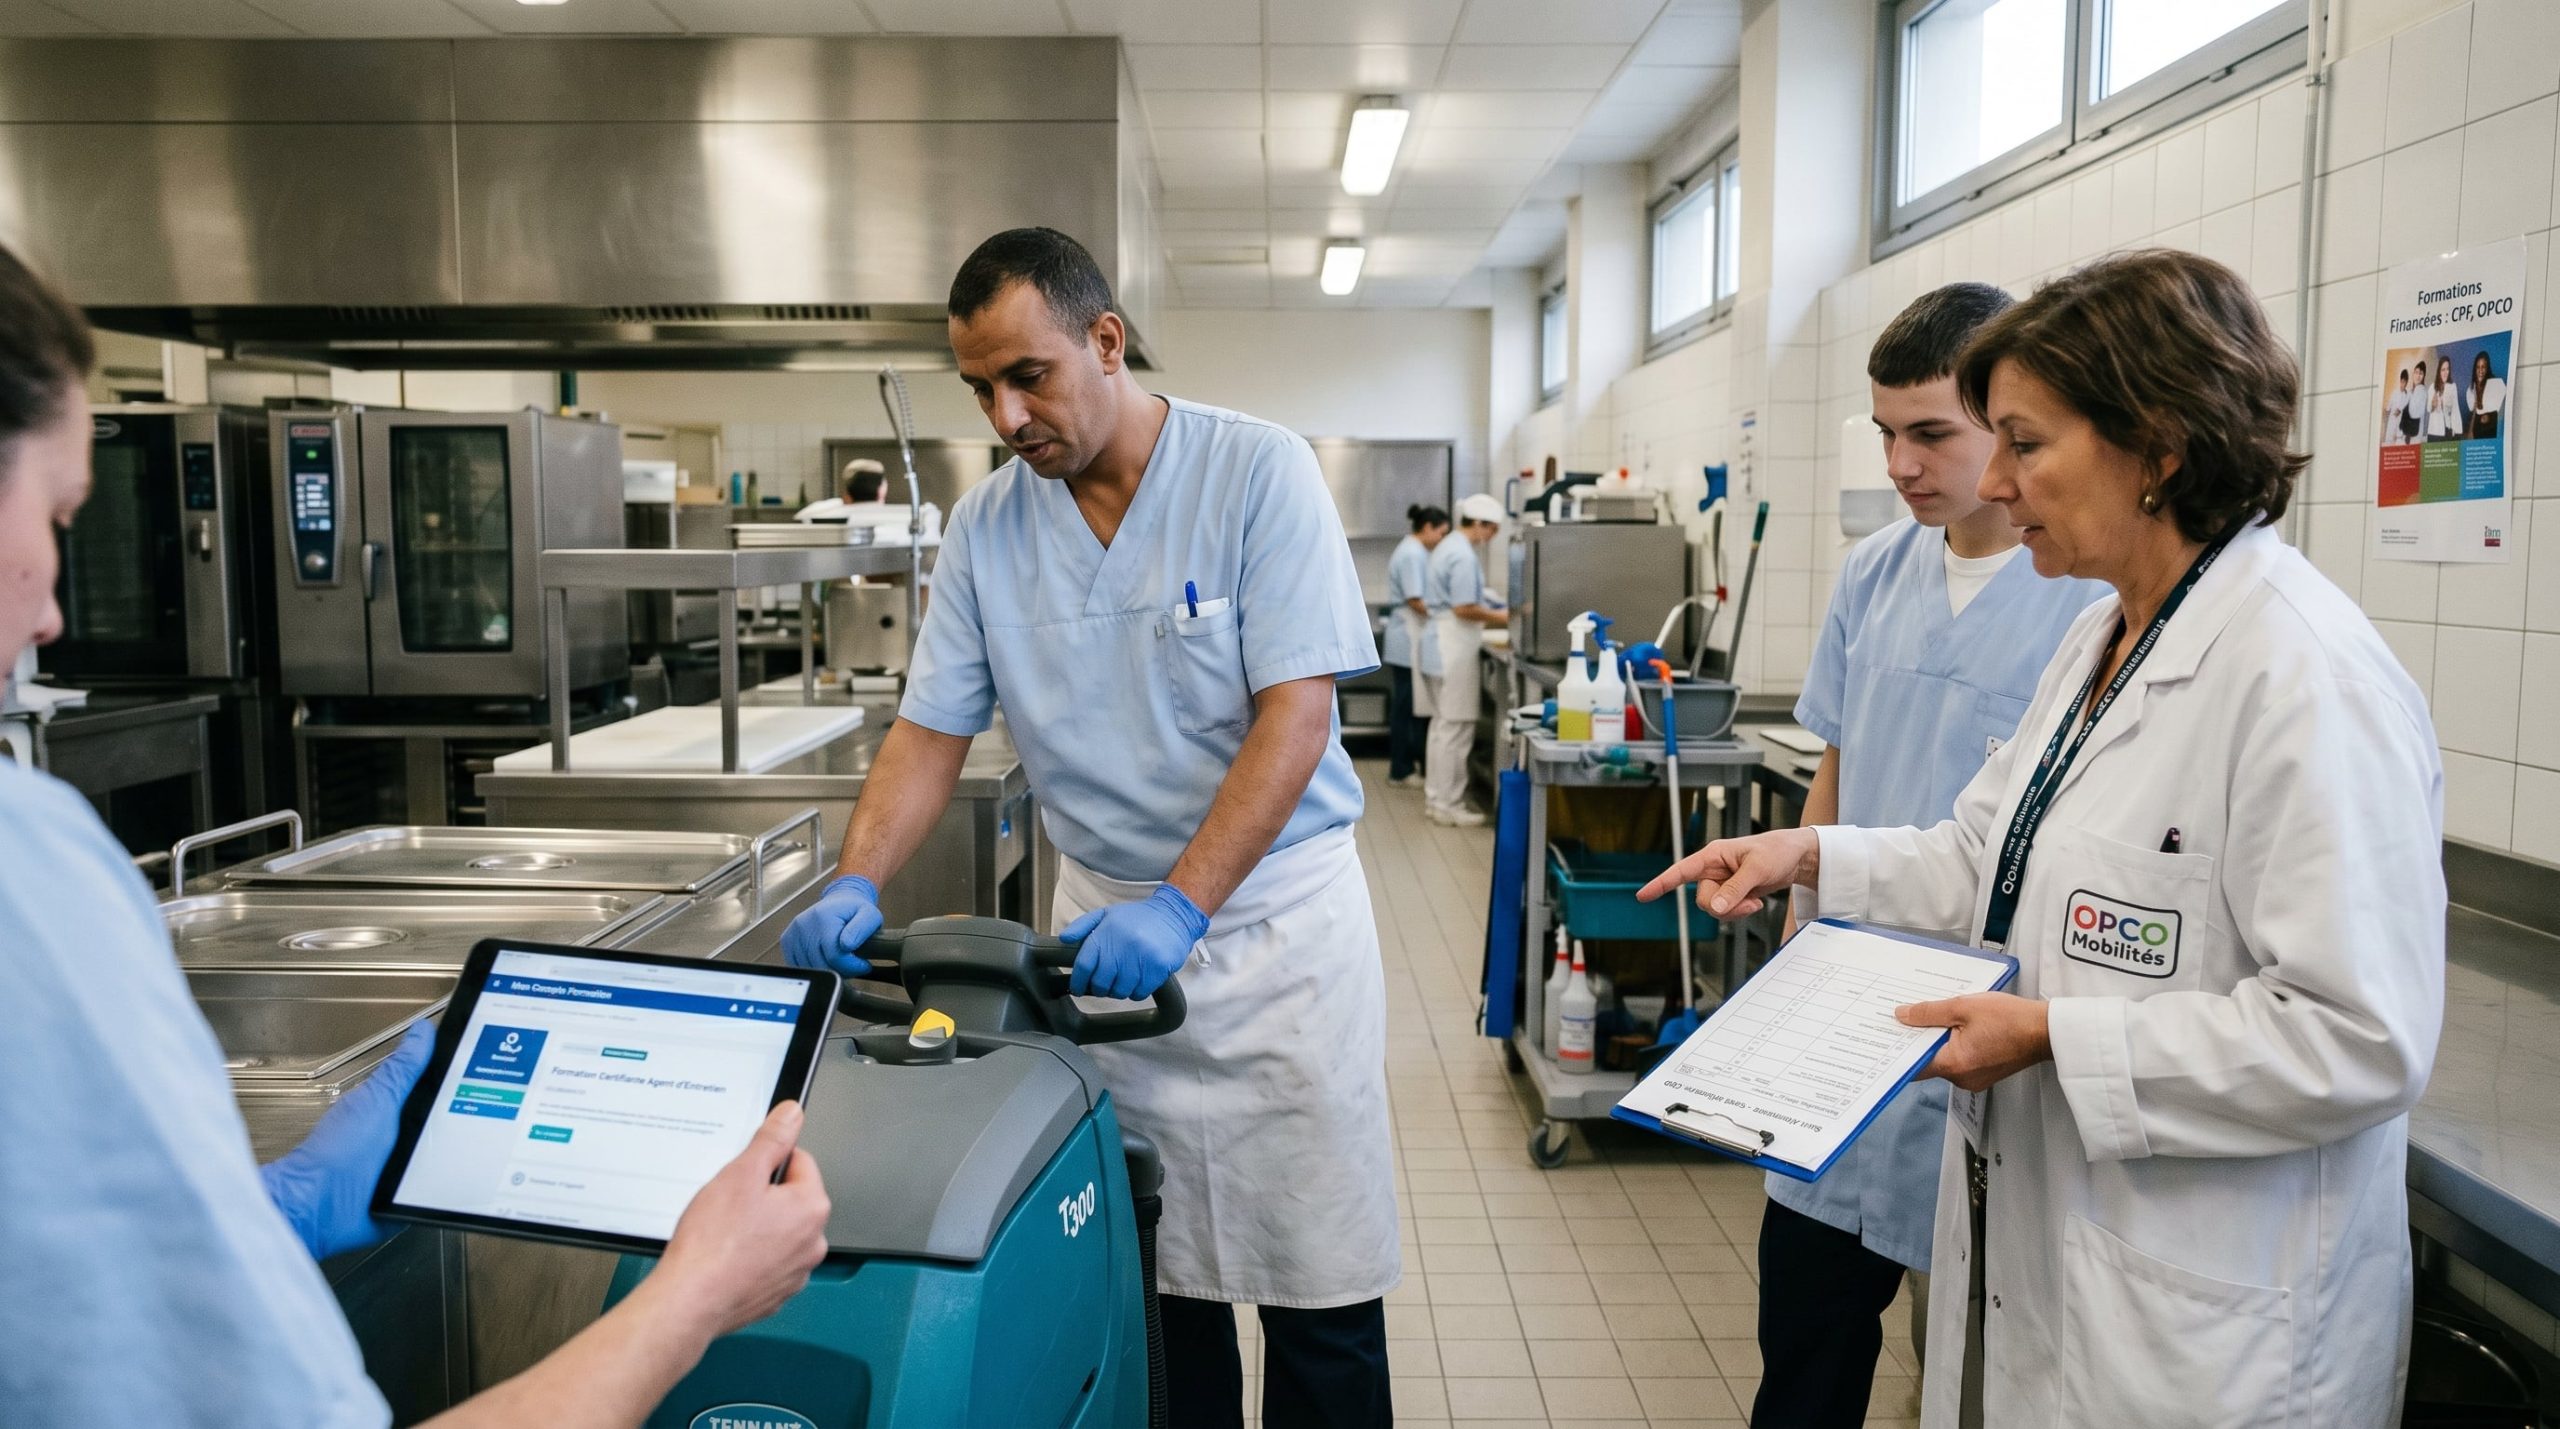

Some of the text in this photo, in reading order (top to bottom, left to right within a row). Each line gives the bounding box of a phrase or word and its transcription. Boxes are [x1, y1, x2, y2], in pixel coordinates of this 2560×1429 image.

[2417, 282, 2482, 306] Formations
[2390, 311, 2442, 334] Financées
[2451, 304, 2475, 322] CPF,
[2477, 297, 2513, 318] OPCO
[2074, 905, 2168, 946] OPCO
[2072, 930, 2165, 966] Mobilités
[551, 1066, 598, 1079] Formation
[647, 1077, 674, 1089] Agent
[1058, 1181, 1095, 1238] T300
